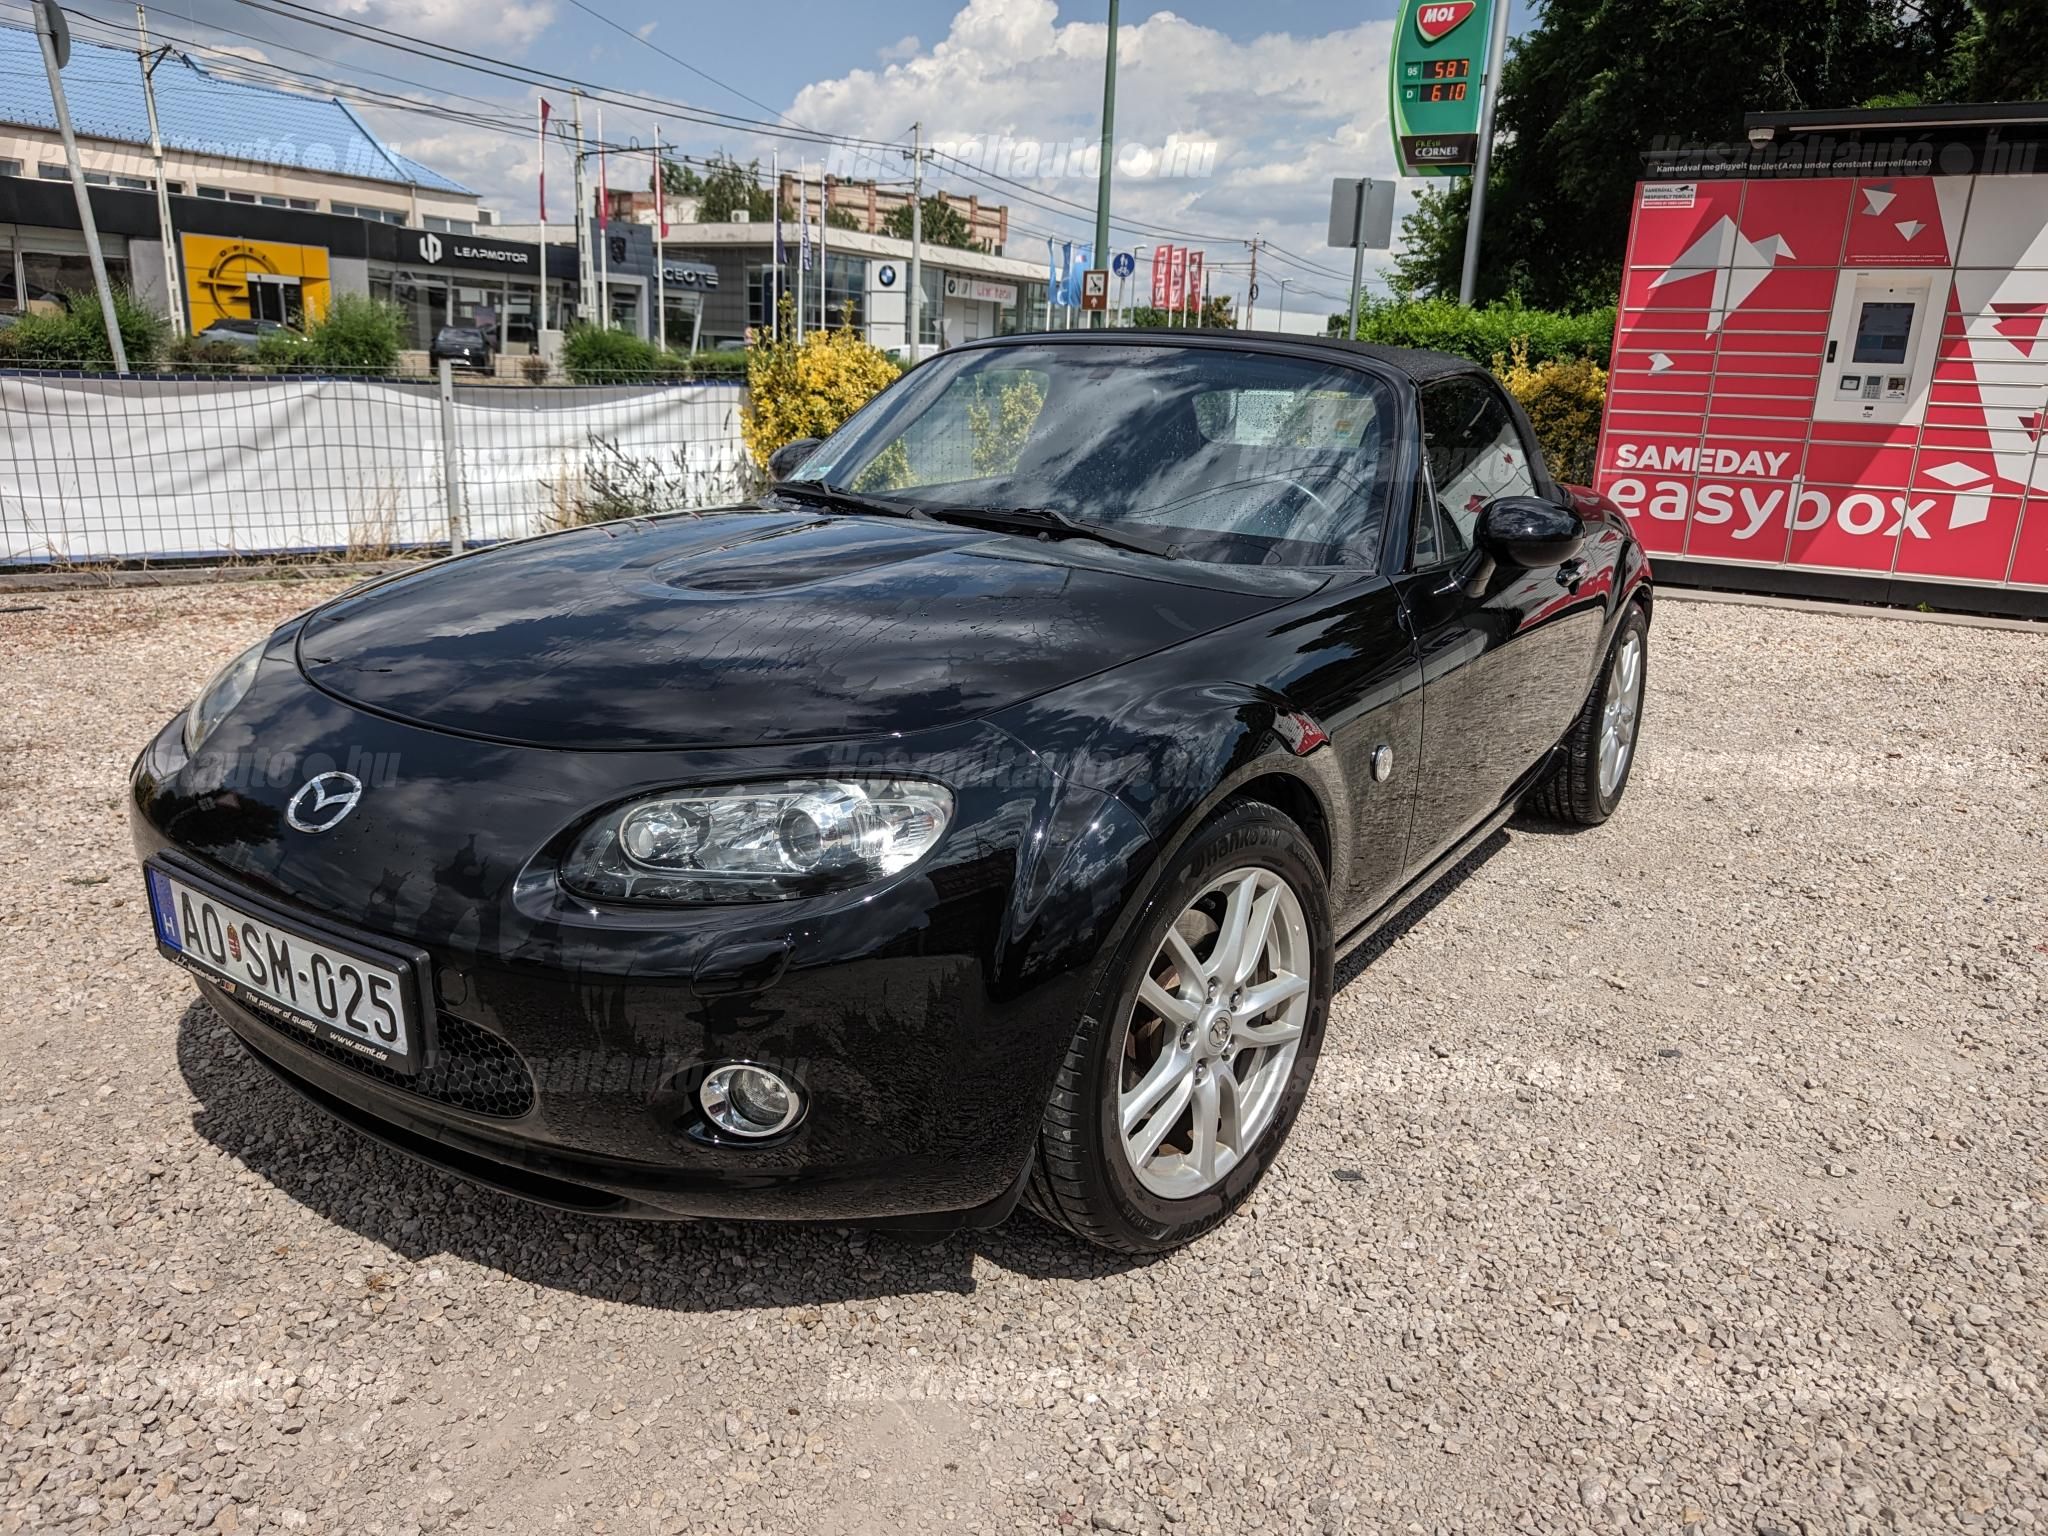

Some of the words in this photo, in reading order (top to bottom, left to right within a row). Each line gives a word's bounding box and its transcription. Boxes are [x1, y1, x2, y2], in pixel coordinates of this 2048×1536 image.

[1422, 6, 1455, 24] MOL
[1407, 65, 1418, 77] 95
[1434, 60, 1470, 79] 587
[1406, 90, 1414, 99] D
[1431, 84, 1466, 102] 610
[1415, 146, 1459, 157] CORNER
[1656, 162, 1700, 173] Kamerával
[1702, 162, 1748, 173] megfigyelt
[1804, 160, 1830, 169] under
[1832, 160, 1871, 169] constant
[453, 246, 529, 264] LEAPMOTOR
[1615, 443, 1791, 476] SAMEDAY
[1607, 473, 1937, 540] easybox
[241, 921, 399, 1043] SM-025
[258, 999, 283, 1015] power
[282, 1010, 293, 1019] of
